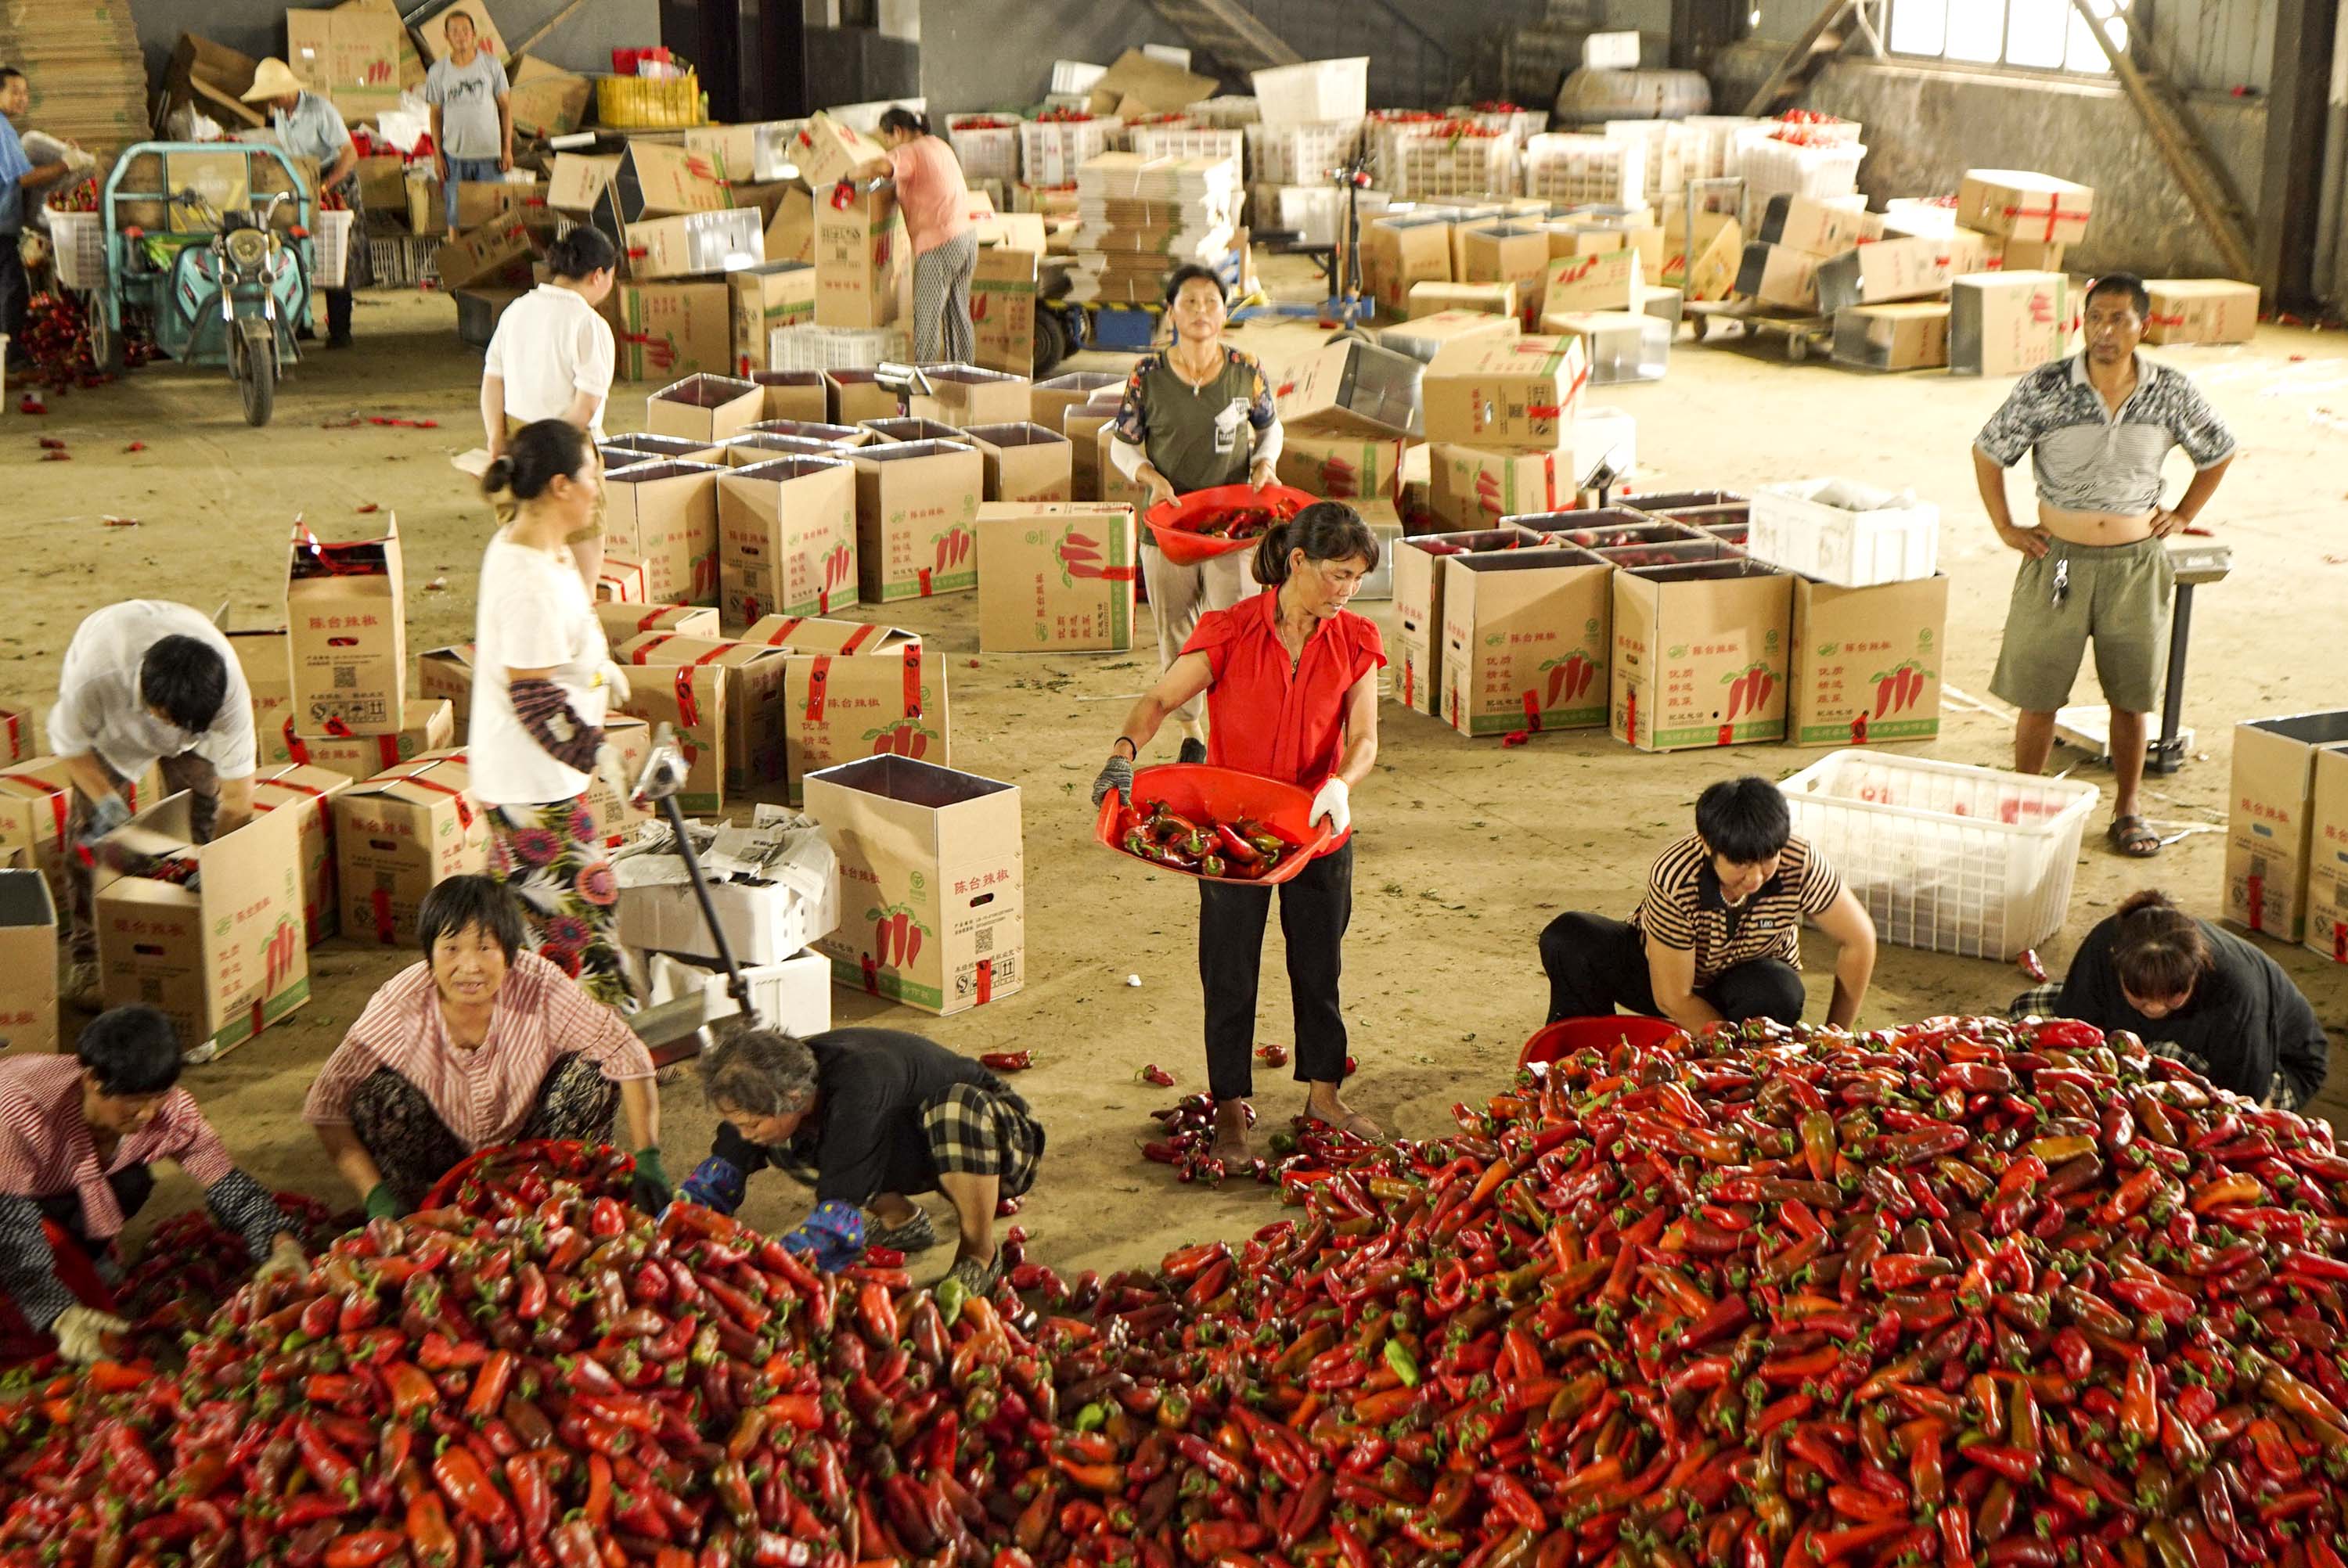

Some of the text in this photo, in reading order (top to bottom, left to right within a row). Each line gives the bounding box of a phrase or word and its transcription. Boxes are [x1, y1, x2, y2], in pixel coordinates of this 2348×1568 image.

[308, 614, 379, 629] 陈台辣椒
[1510, 631, 1557, 644] 陈台辣椒
[827, 698, 880, 708] 陈台辣椒
[801, 721, 830, 731] 优质
[954, 869, 1010, 895] 陈台辣椒
